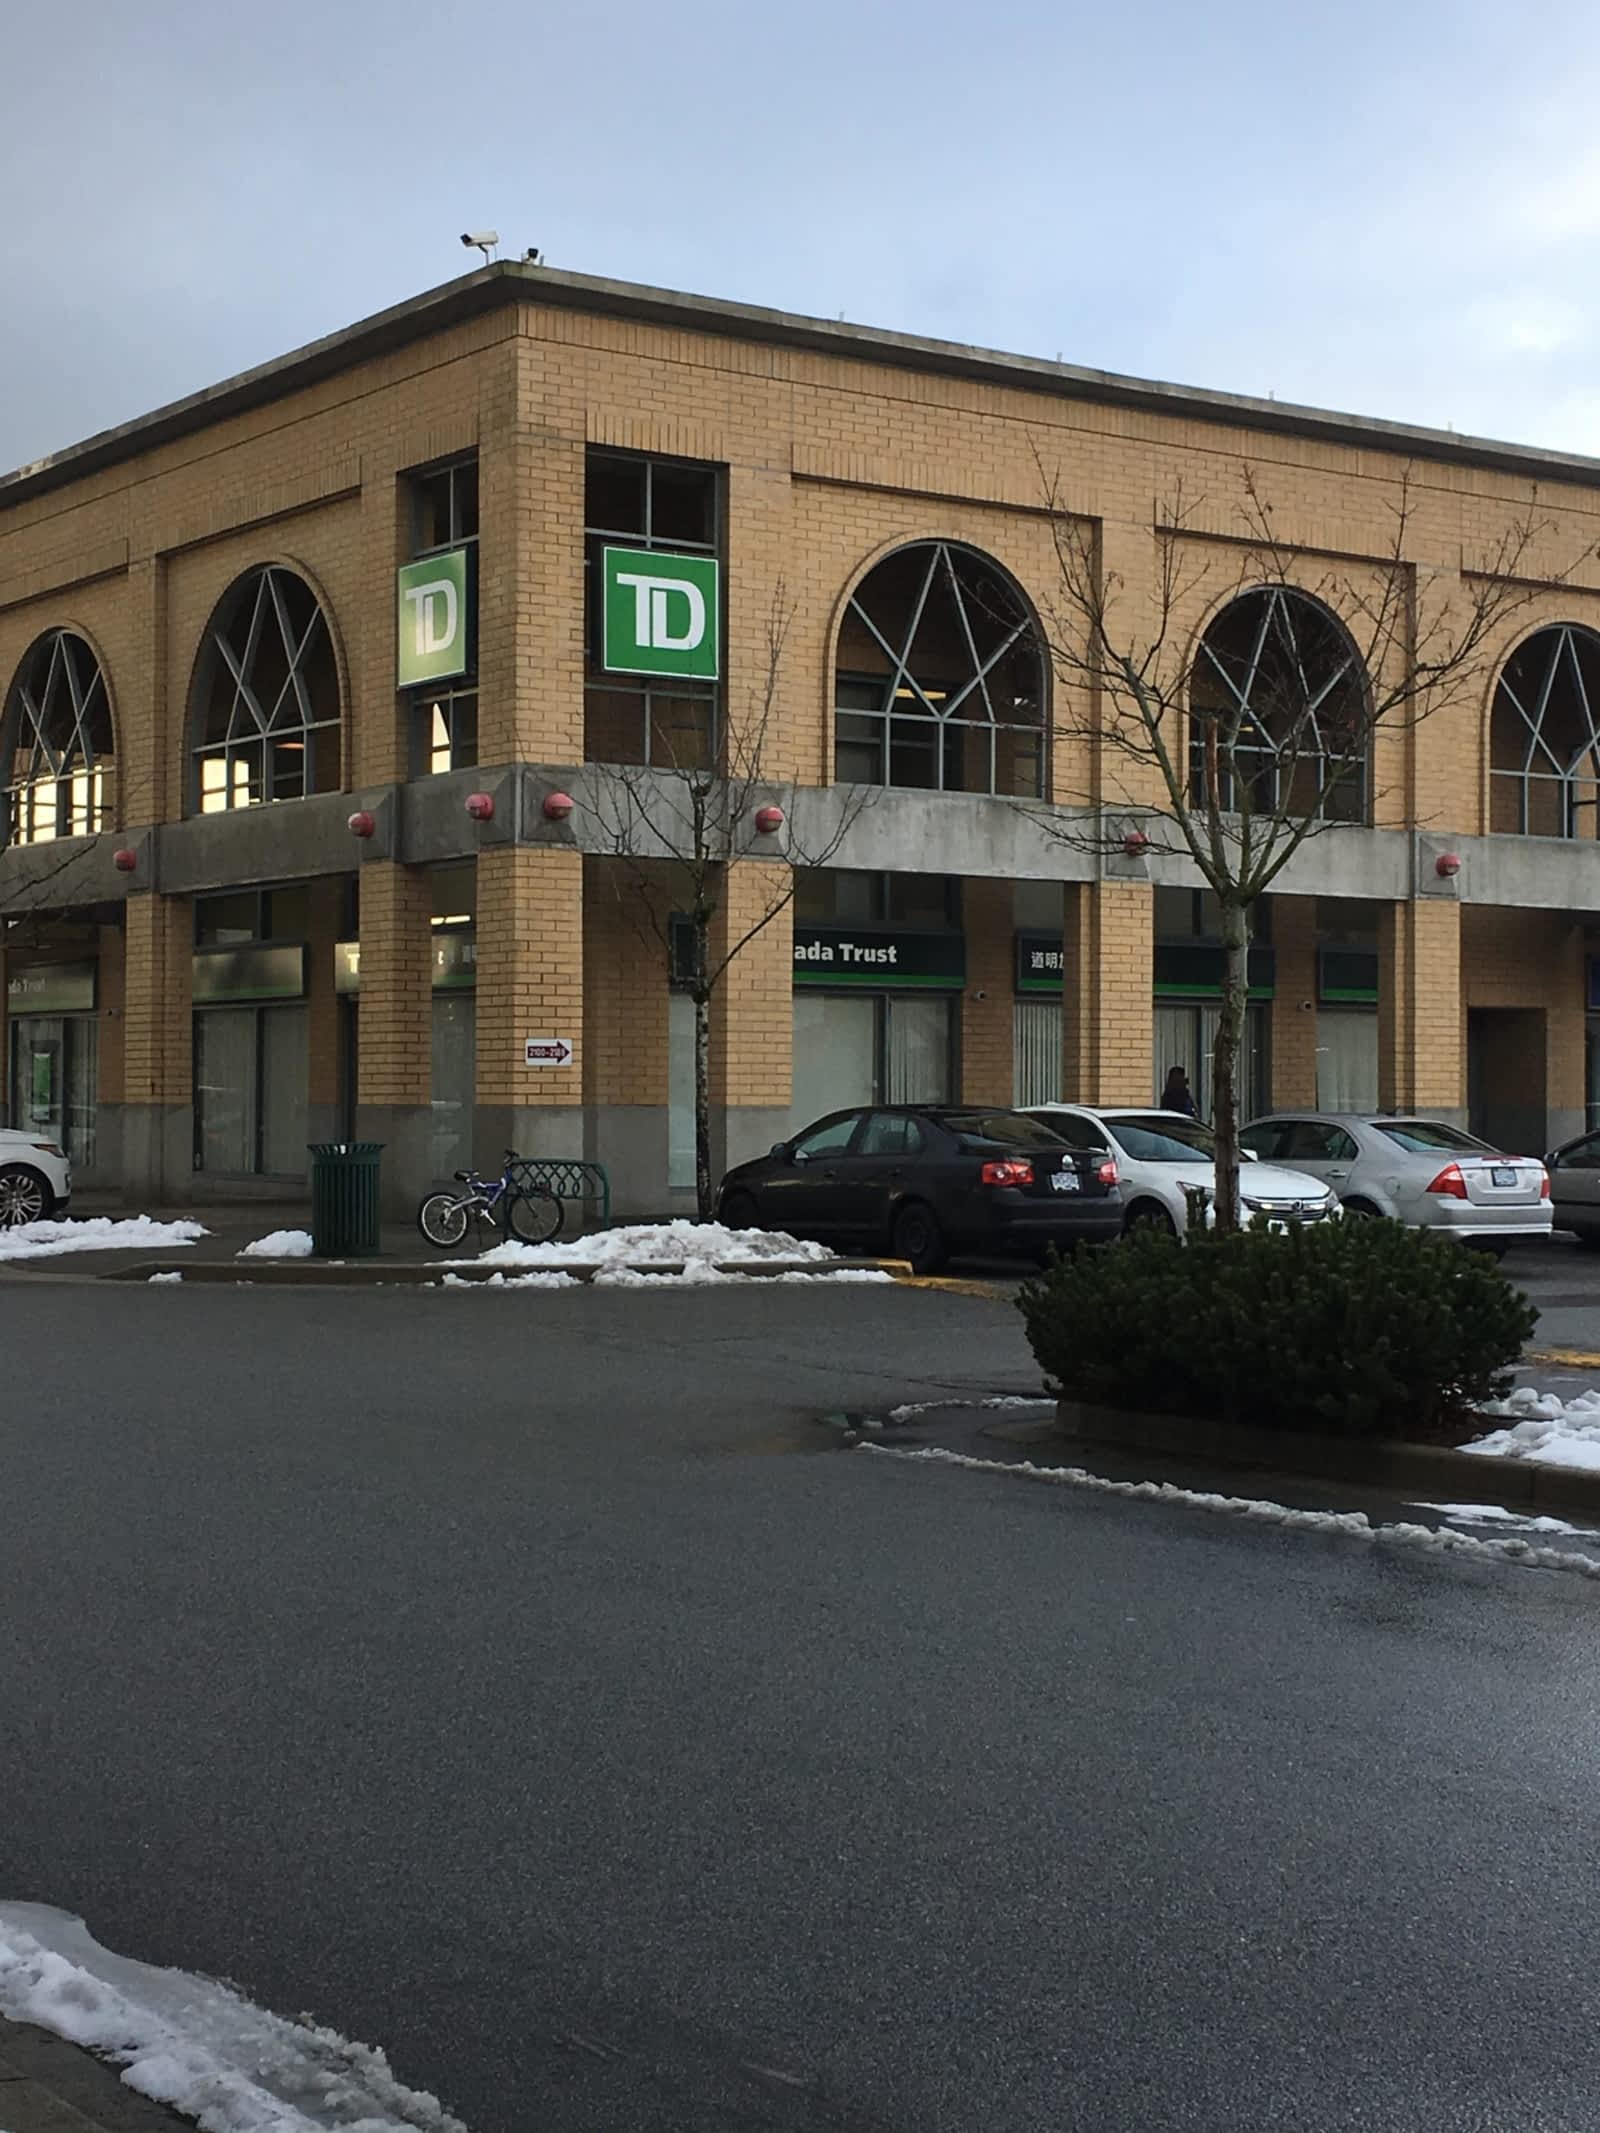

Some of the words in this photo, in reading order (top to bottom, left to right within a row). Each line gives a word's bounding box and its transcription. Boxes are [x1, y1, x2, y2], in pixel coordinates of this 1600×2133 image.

[405, 579, 458, 656] TD
[616, 573, 706, 651] TD
[794, 940, 834, 961] ada
[838, 943, 897, 963] Trust
[1031, 952, 1064, 969] 道明
